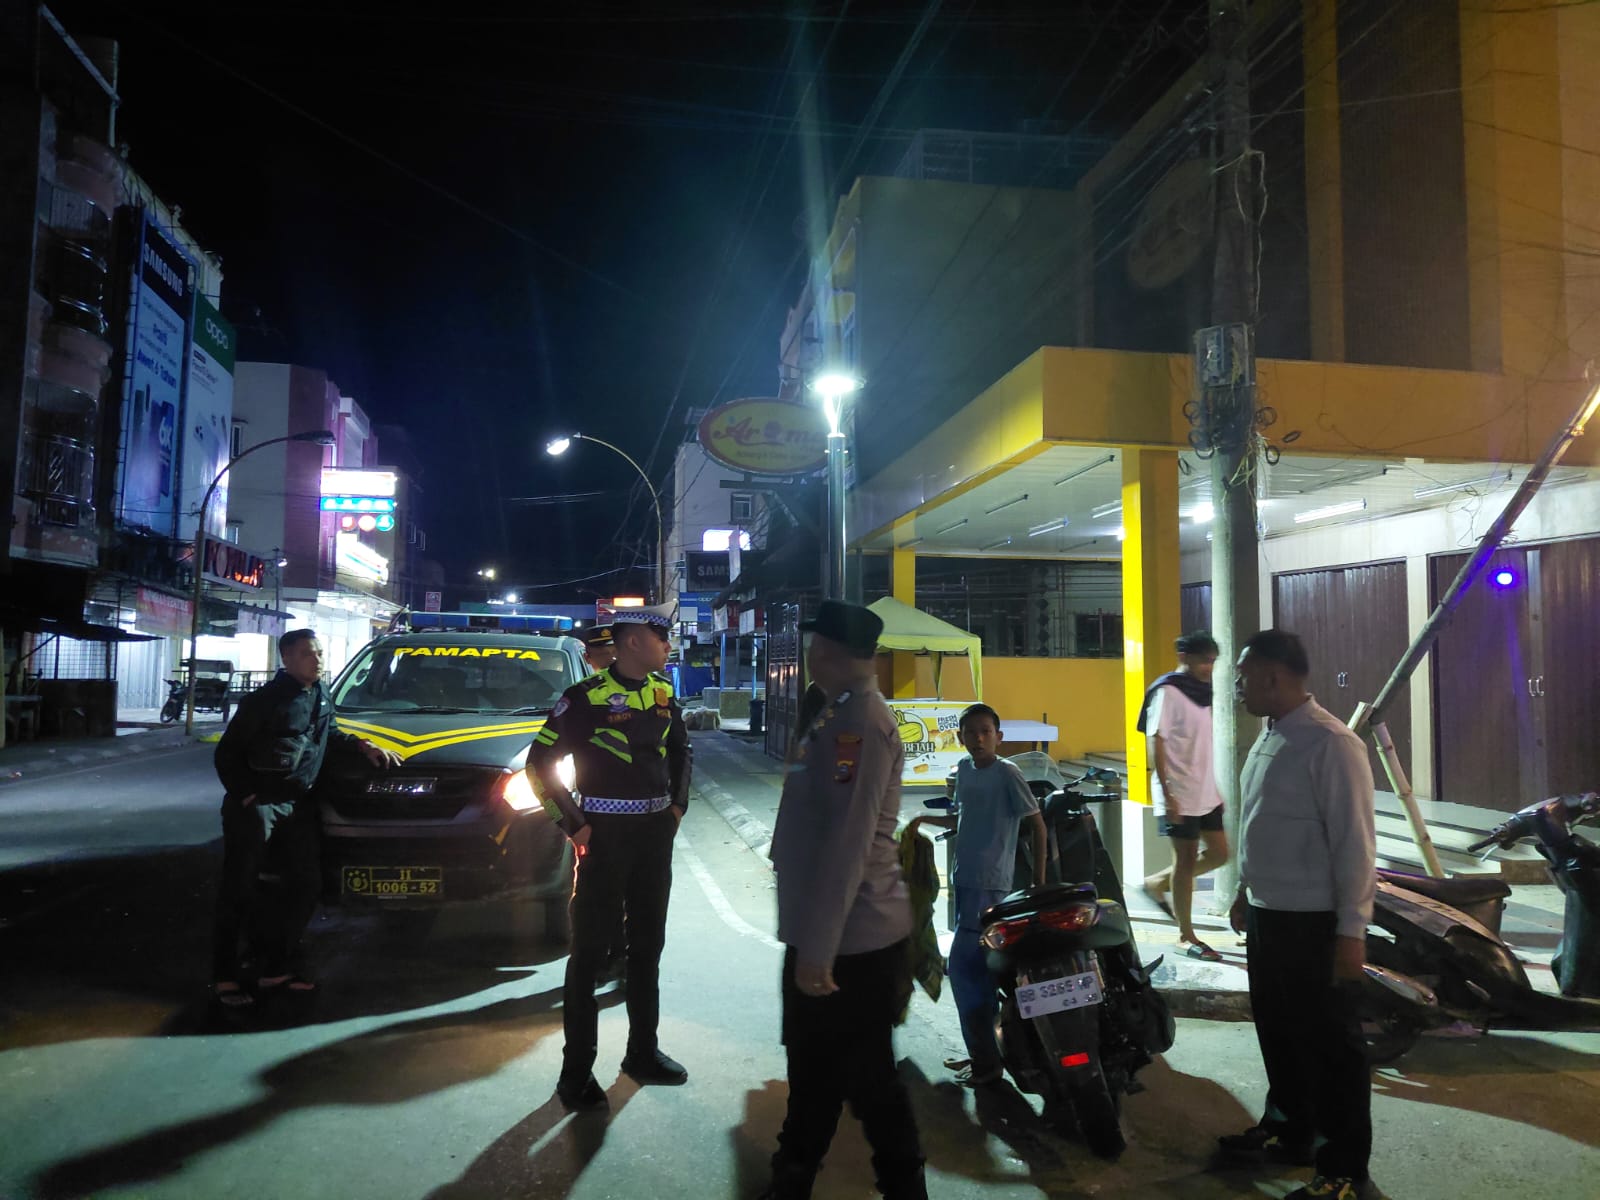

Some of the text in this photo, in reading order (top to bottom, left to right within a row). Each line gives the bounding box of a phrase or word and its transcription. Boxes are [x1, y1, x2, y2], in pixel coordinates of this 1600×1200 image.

[143, 242, 183, 297] SAMSUNG
[697, 565, 730, 577] SAM
[393, 647, 541, 661] PAMAPTA
[939, 722, 959, 731] OVEN
